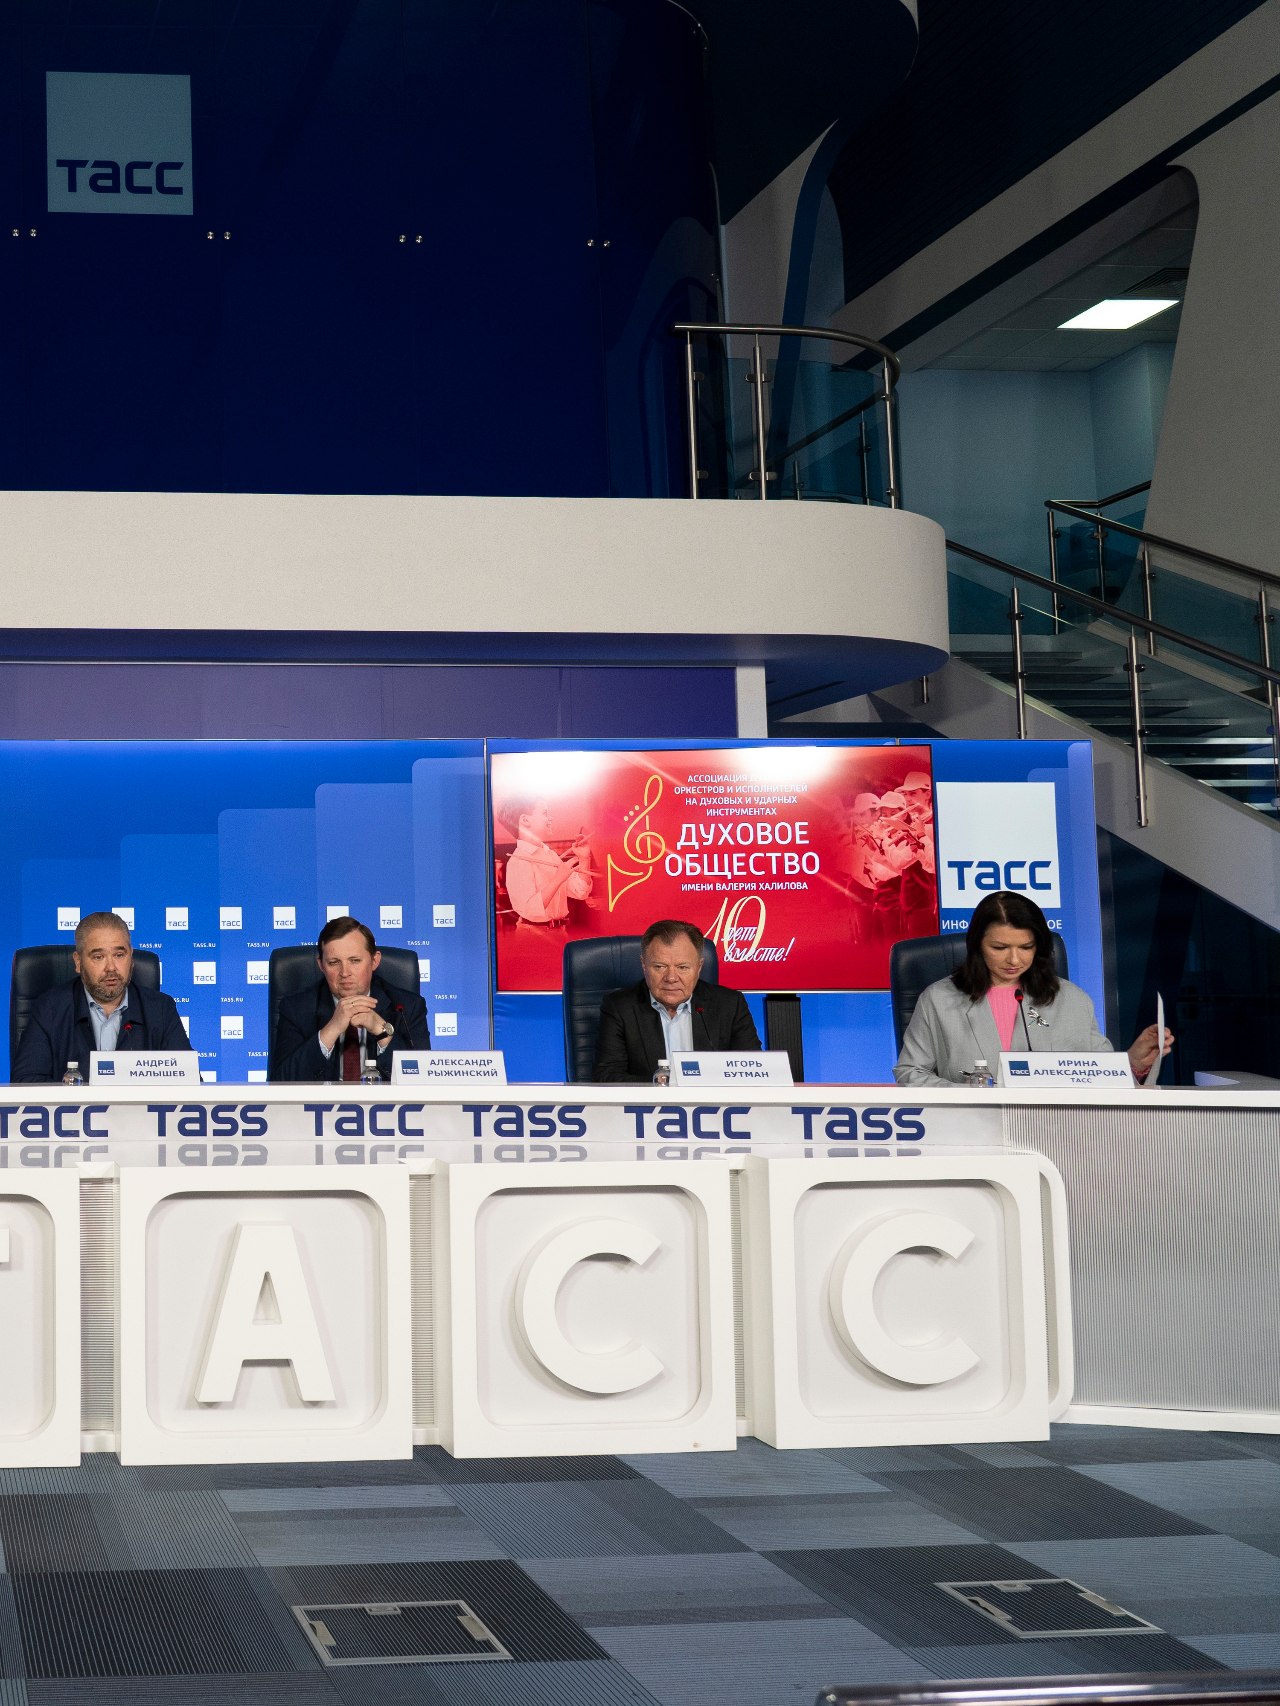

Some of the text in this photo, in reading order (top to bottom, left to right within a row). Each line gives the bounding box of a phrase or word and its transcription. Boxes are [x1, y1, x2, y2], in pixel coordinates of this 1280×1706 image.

[687, 774, 747, 783] АССОЦИАЦИЯ
[674, 786, 724, 795] ОРКЕСТРОВ
[735, 784, 808, 793] ИСПОЛНИТЕЛЕЙ
[685, 795, 797, 806] НА ДУХОВЫХ И УДАРНЫХ
[706, 807, 777, 816] ИНСТРУМЕНТАХ
[676, 822, 810, 850] ДУХОВОЕ
[664, 852, 820, 879] ОБЩЕСТВО
[681, 882, 808, 891] ИМЕНИ ВАЛЕРИЯ ХАЛИЛОВА
[703, 895, 766, 963] 10
[136, 1057, 177, 1067] АНДРЕЙ
[429, 1059, 493, 1067] АЛЕКСАНДР
[427, 1068, 498, 1077] РЫЖИНСКИЙ
[1033, 1069, 1127, 1077] АЛЕКСАНДРОВА
